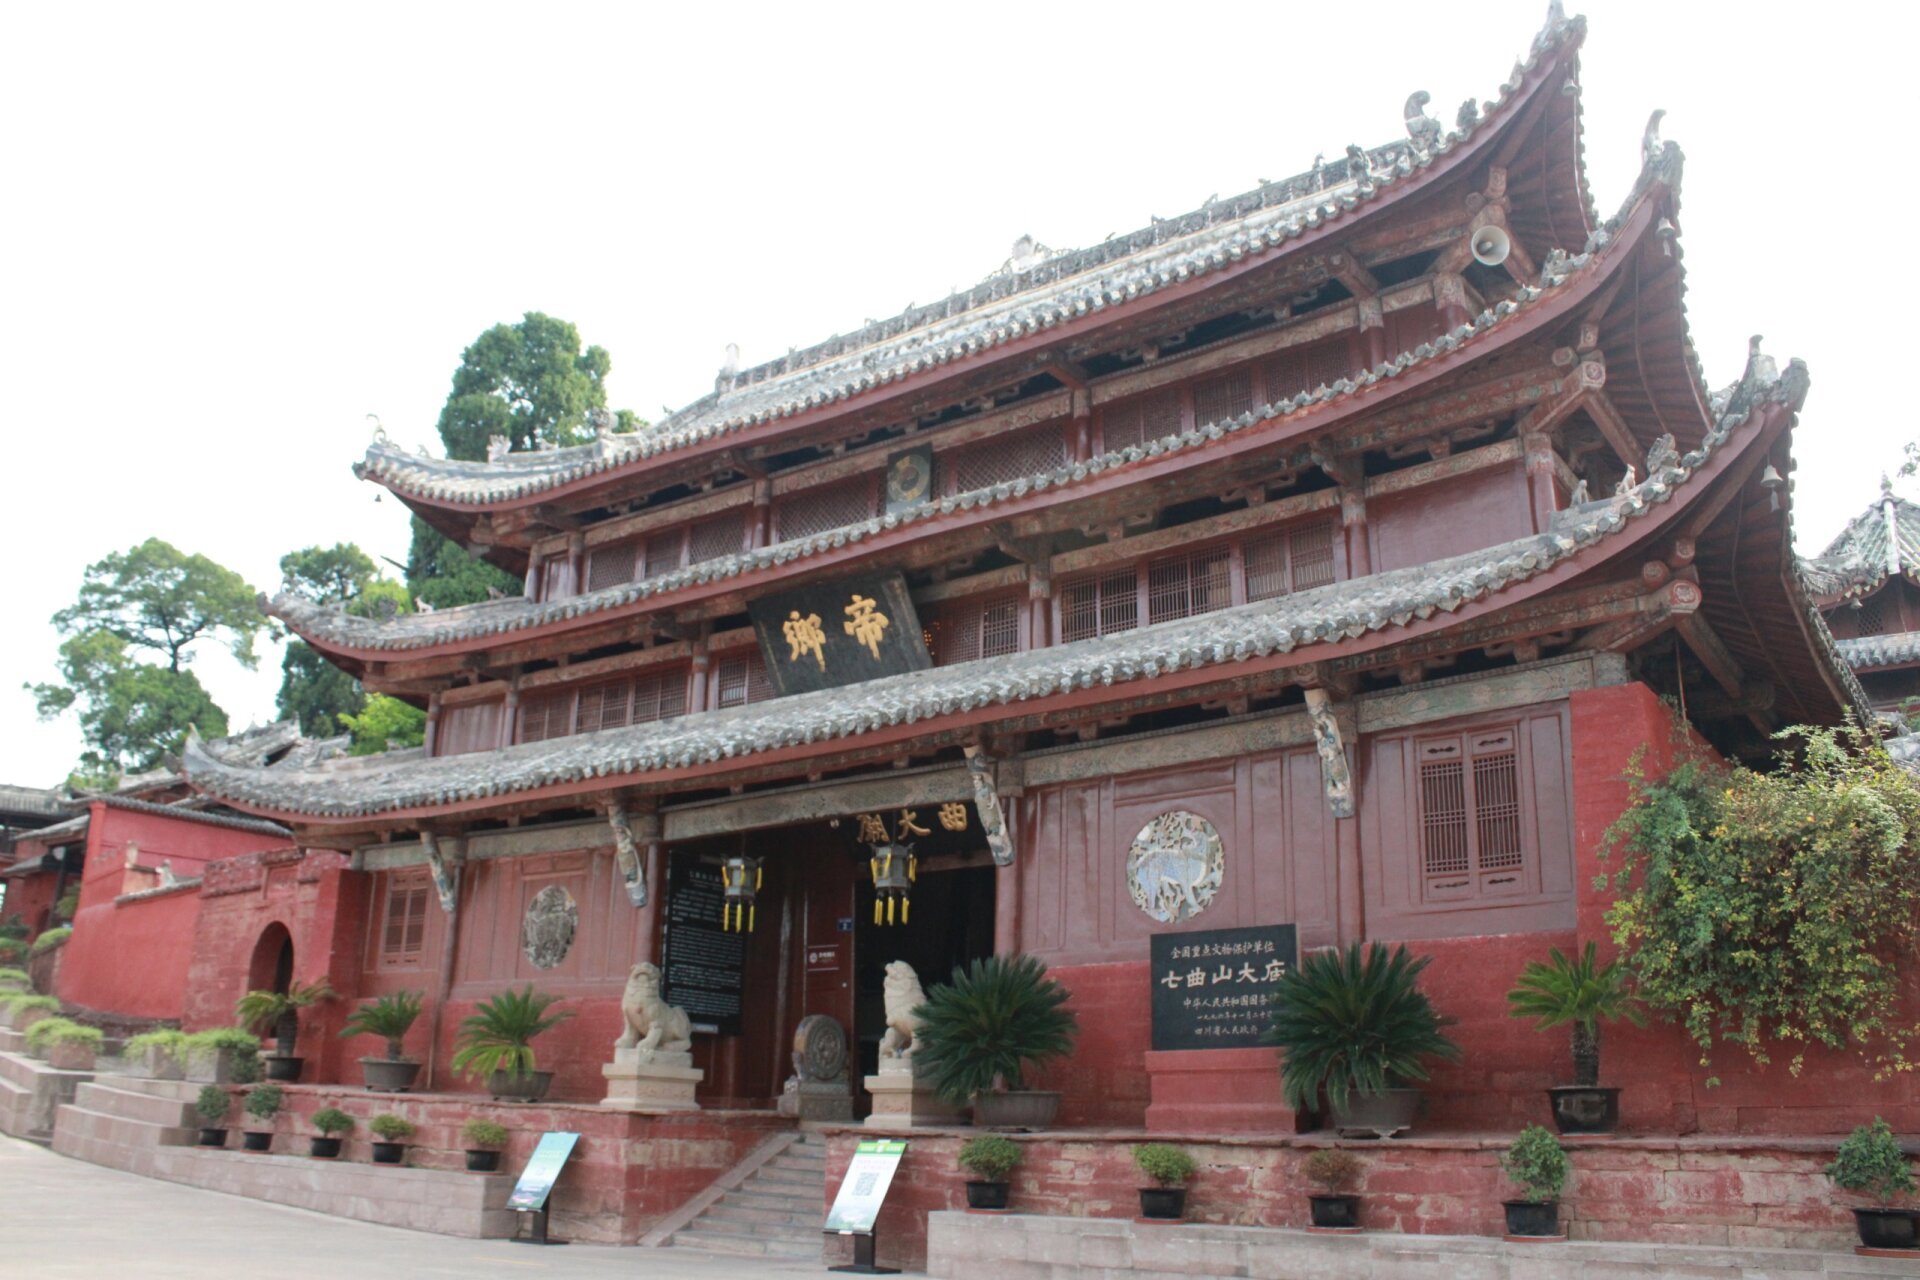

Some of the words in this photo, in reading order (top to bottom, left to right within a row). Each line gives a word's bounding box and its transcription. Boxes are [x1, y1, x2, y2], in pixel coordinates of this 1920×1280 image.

[1171, 940, 1275, 959] 全国重点文物保护单位
[1161, 959, 1285, 988] 七曲山大庙
